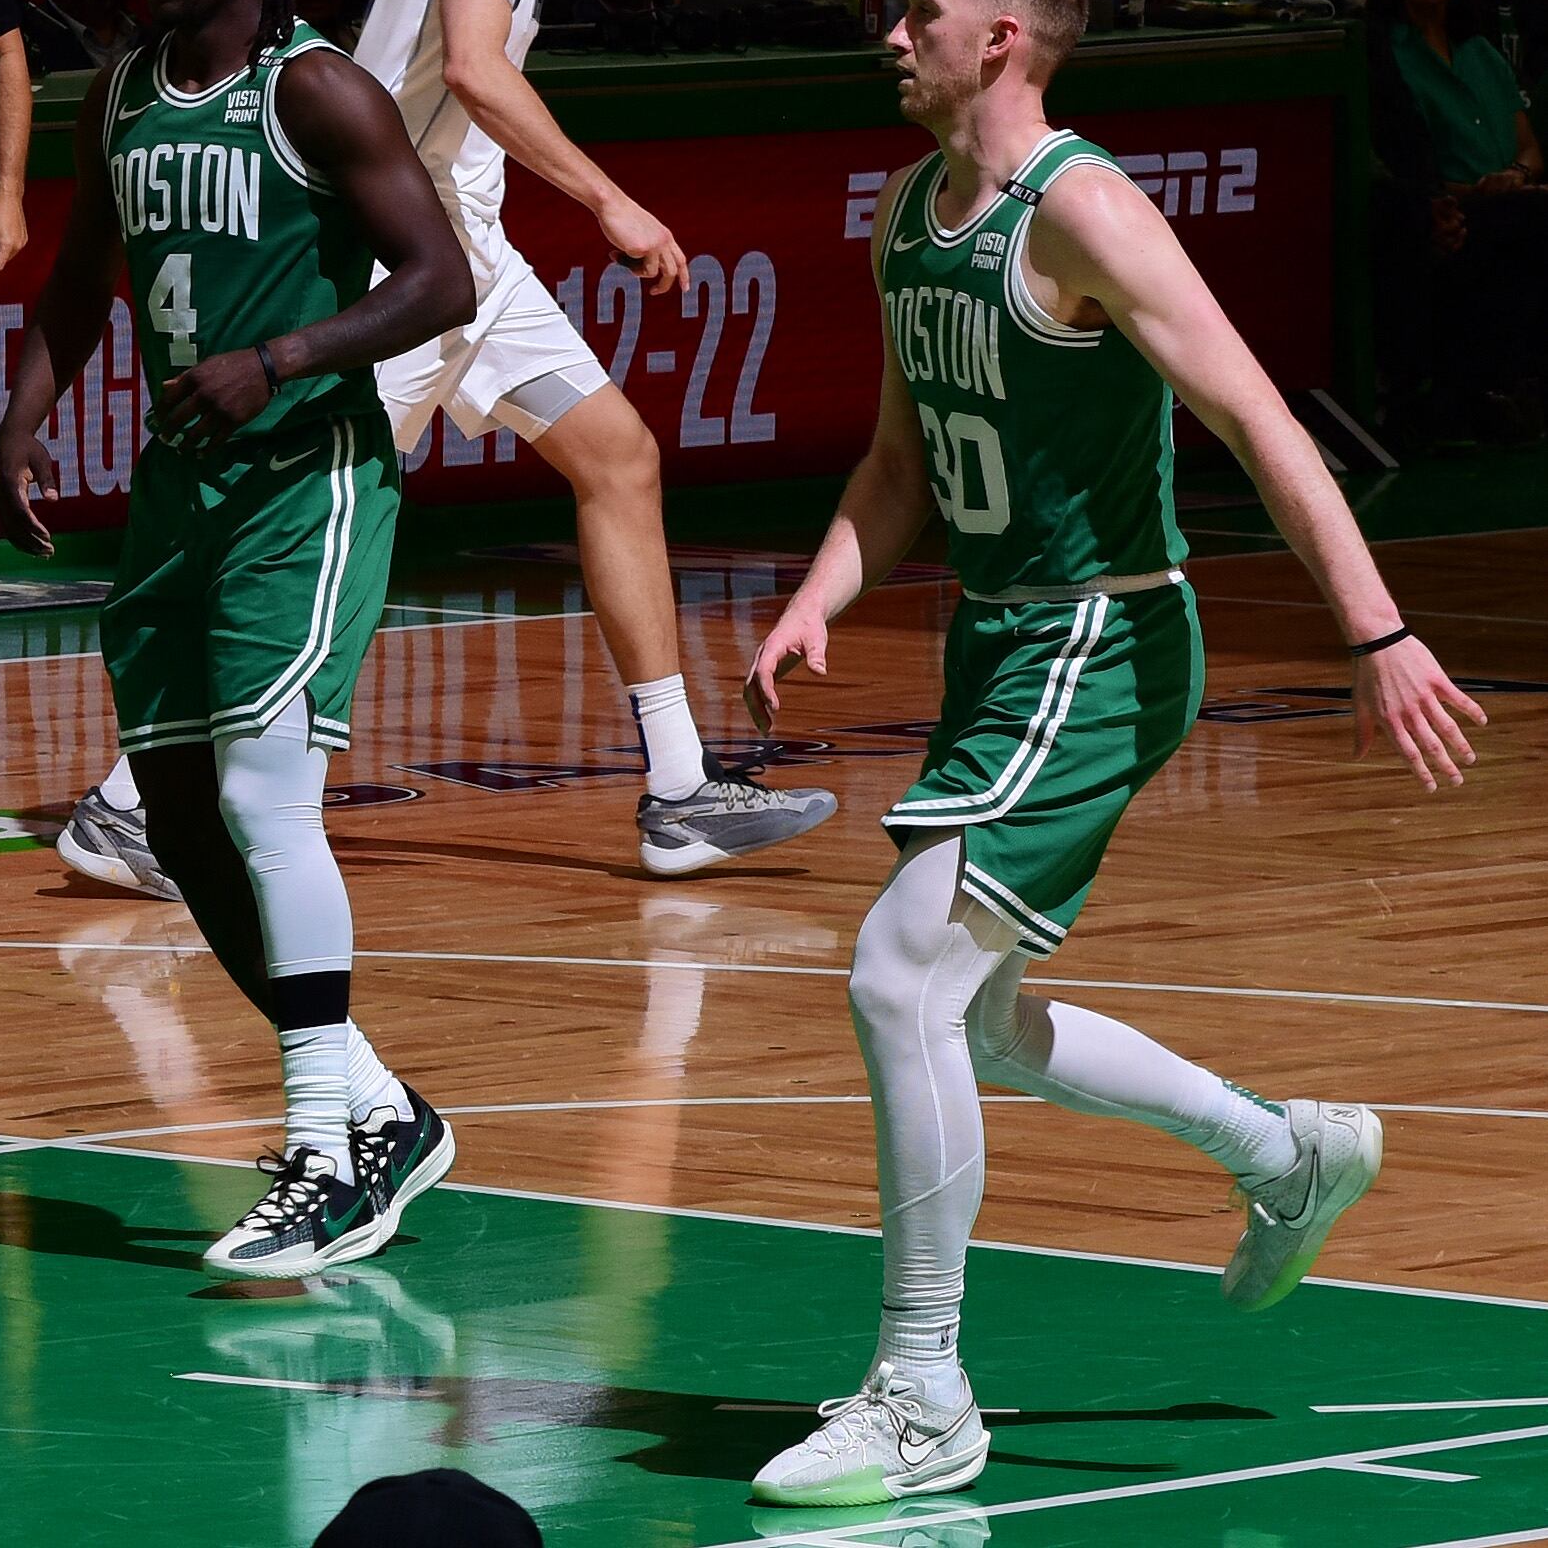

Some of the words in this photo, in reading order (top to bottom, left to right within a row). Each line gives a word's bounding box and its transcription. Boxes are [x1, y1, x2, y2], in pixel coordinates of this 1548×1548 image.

[226, 90, 262, 109] VISTA
[223, 108, 260, 125] PRINT
[109, 143, 262, 243] BOSTON
[974, 231, 1007, 255] VISTA
[970, 252, 1004, 272] PRINT
[147, 253, 199, 367] 4
[917, 401, 1011, 535] 30
